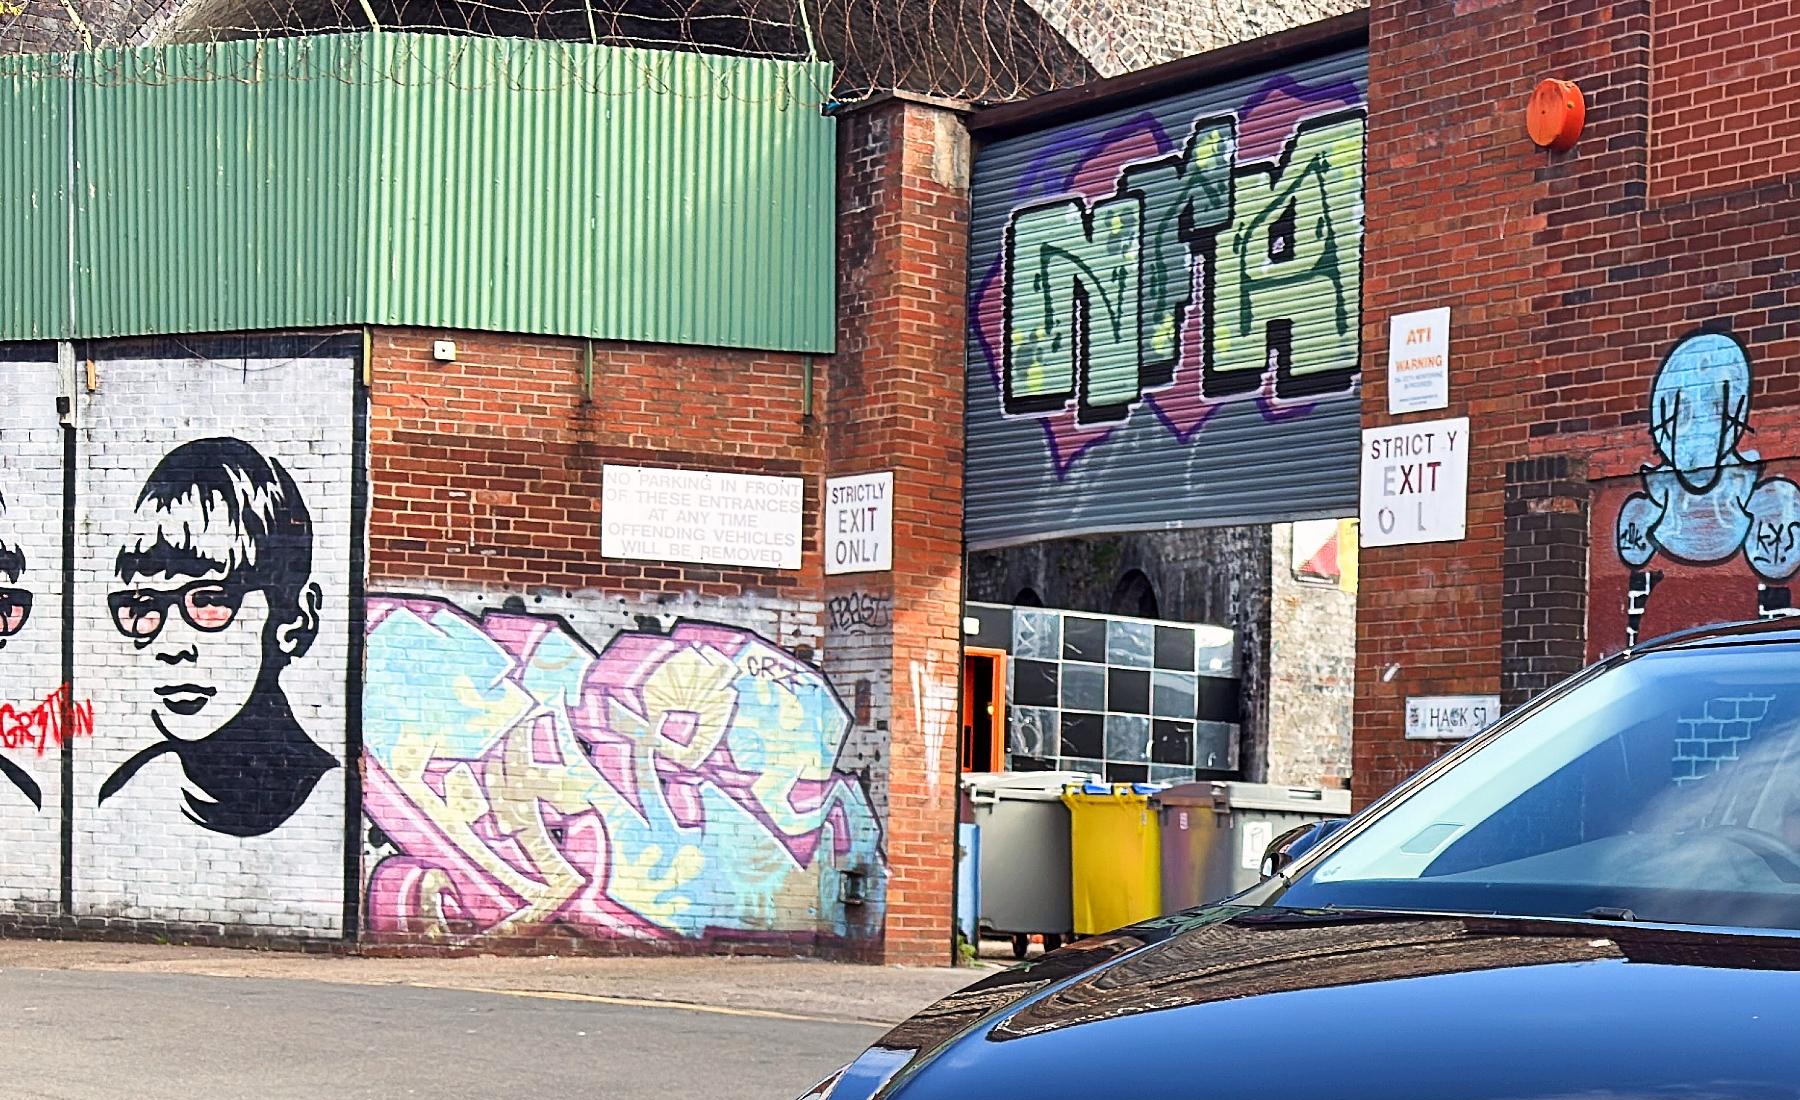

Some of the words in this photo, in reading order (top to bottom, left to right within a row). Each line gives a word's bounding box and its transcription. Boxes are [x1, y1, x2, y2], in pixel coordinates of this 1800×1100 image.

[1406, 327, 1432, 345] ATI
[1371, 430, 1457, 459] STRICTY
[606, 472, 631, 486] NO
[639, 474, 712, 491] PARKING
[721, 479, 737, 492] IN
[745, 481, 800, 497] FRONT
[1383, 462, 1442, 496] EXIT
[606, 488, 628, 501] OF
[637, 490, 691, 506] THESE
[699, 495, 801, 514] ENTRANCES
[832, 482, 886, 504] STRICTLY
[648, 508, 666, 521] AT
[676, 510, 710, 525] ANY
[718, 512, 759, 528] TIME
[839, 507, 878, 533] EXIT
[608, 522, 705, 541] OFFENDING
[714, 529, 796, 547] VEHICLES
[621, 540, 661, 555] WILL
[670, 543, 690, 556] BE
[701, 545, 783, 562] REMOVED
[1430, 707, 1468, 727] HACK
